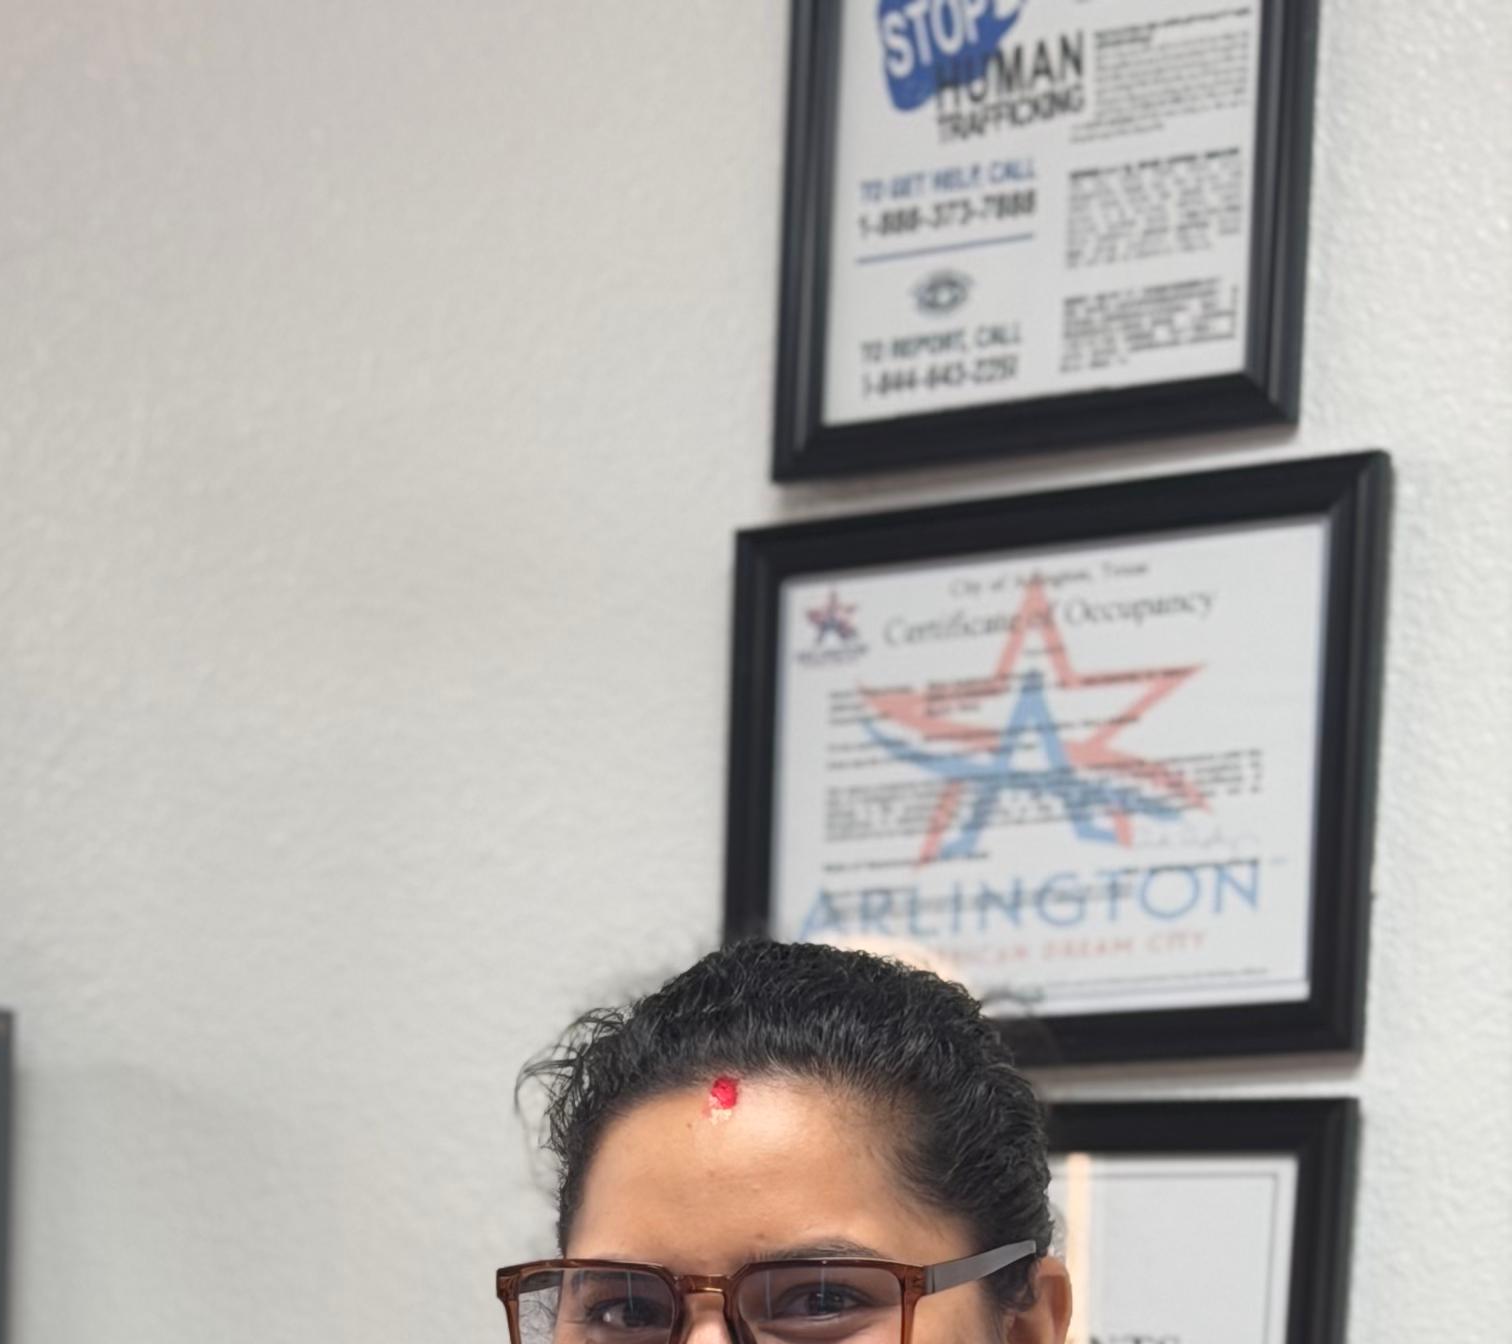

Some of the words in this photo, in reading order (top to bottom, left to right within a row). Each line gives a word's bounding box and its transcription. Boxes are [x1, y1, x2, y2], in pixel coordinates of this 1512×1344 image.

[938, 29, 1084, 112] HUMAN
[937, 84, 1085, 143] TRAFFICKING
[1064, 588, 1218, 631] Occupancy
[799, 861, 1260, 941] ARLINGTON
